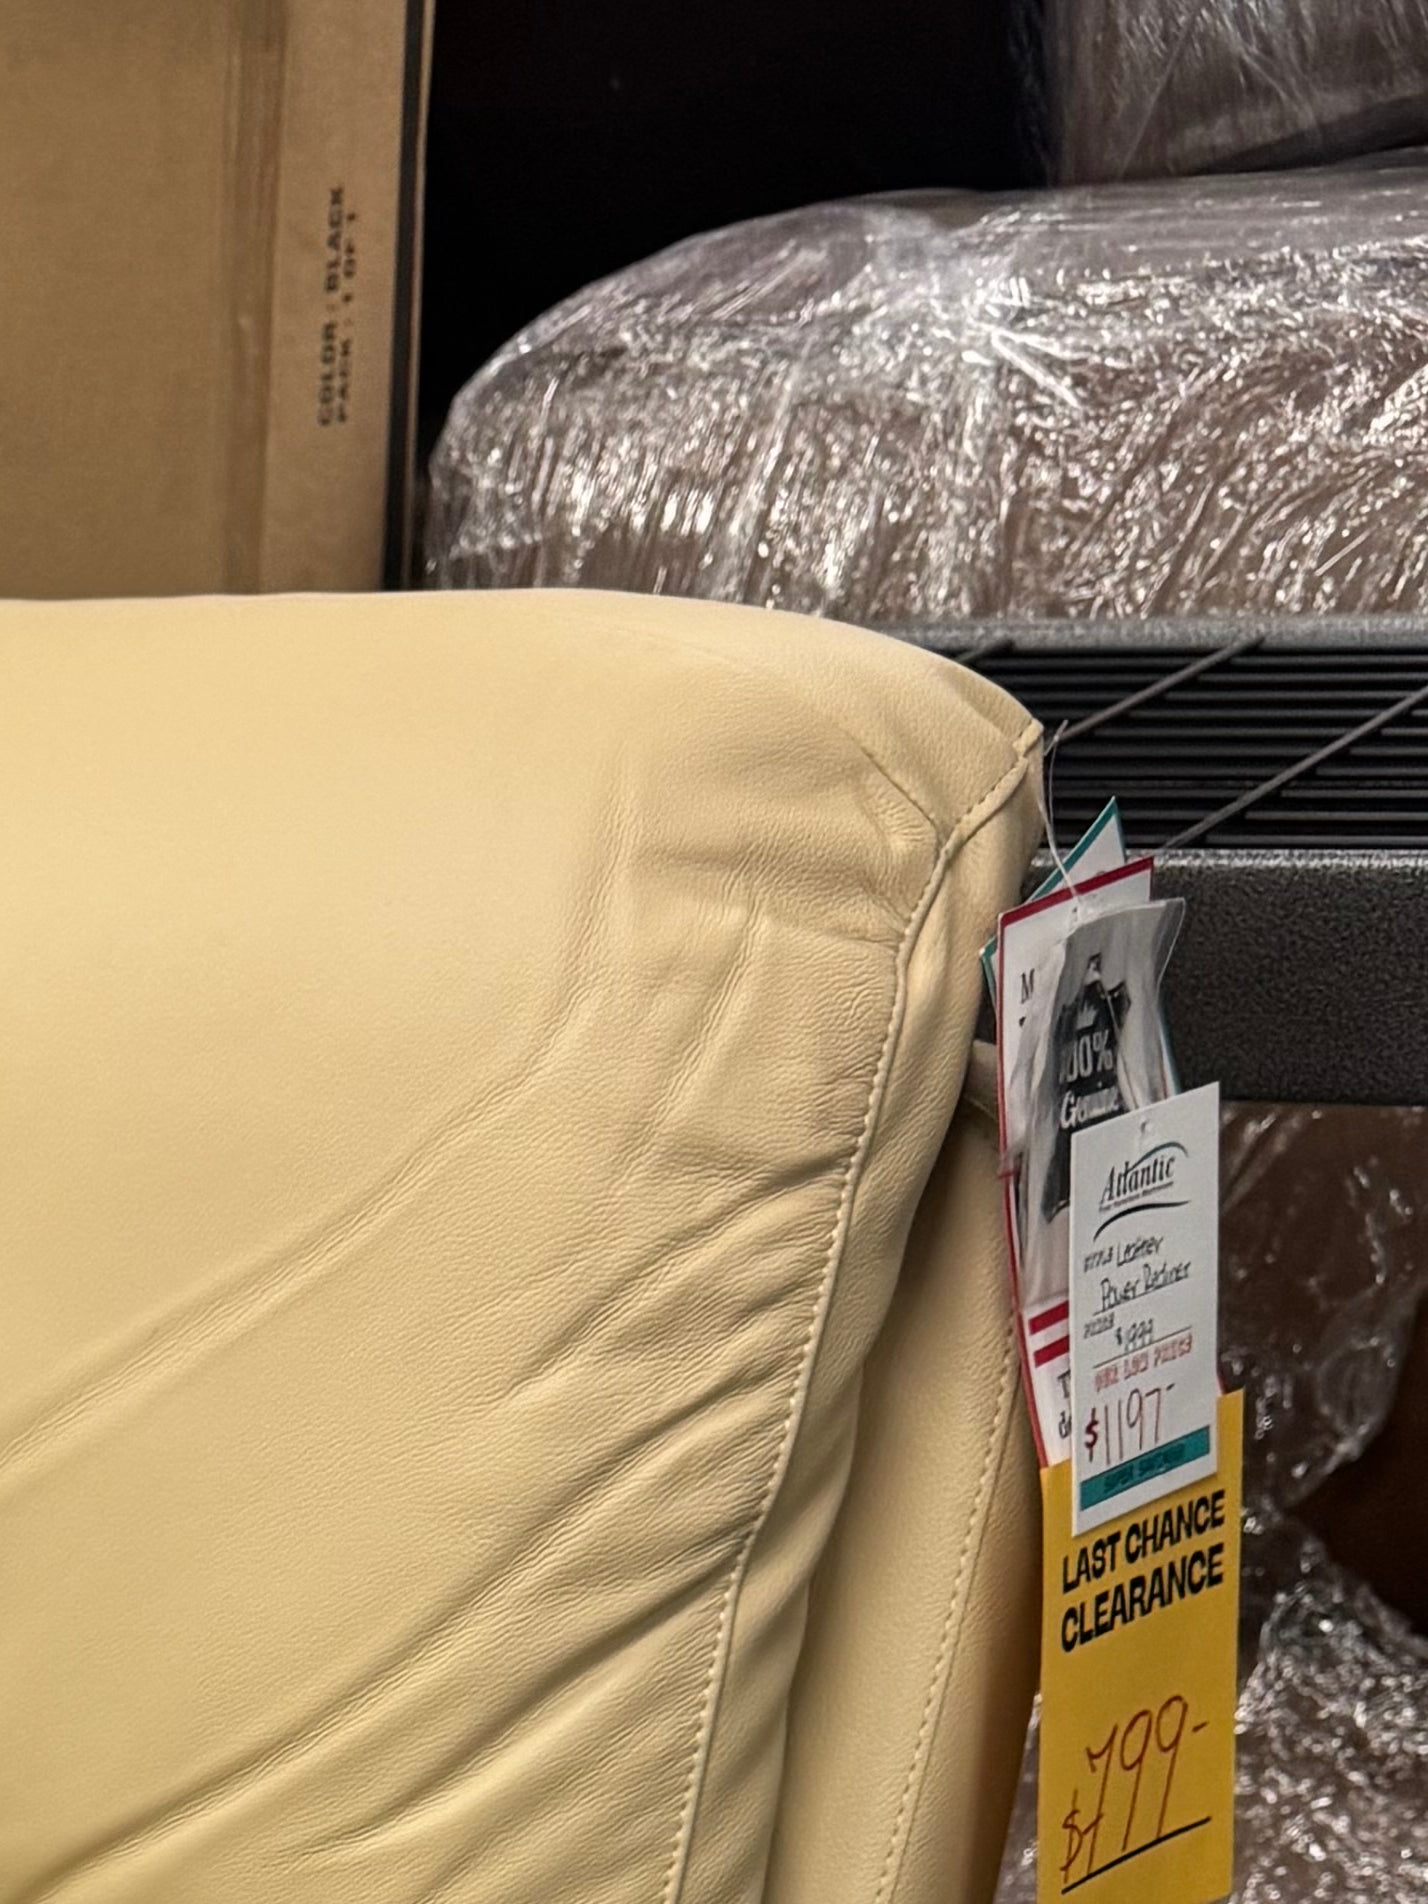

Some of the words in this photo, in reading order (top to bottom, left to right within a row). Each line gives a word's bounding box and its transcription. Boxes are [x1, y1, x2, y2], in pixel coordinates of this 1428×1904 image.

[1099, 1156, 1176, 1206] Atlantic
[1063, 1531, 1121, 1594] LAST
[1125, 1489, 1225, 1564] CHANCE
[1062, 1542, 1225, 1653] CLEARANCE
